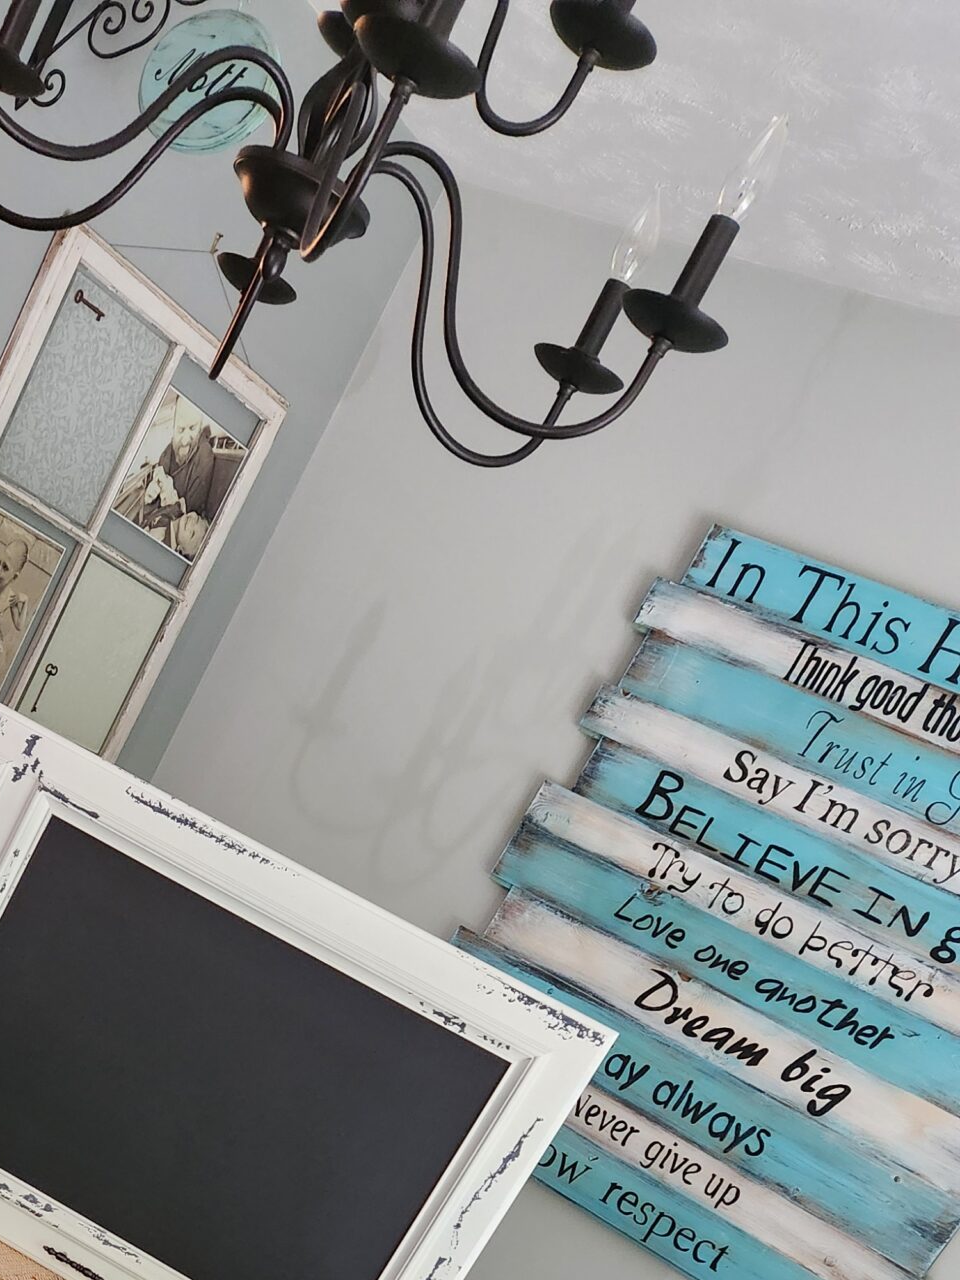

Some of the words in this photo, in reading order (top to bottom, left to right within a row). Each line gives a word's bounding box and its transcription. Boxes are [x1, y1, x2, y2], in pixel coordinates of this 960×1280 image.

[707, 538, 767, 604] In
[789, 564, 912, 655] This
[783, 638, 861, 703] Think
[848, 663, 932, 723] good
[797, 710, 893, 787] Trust
[892, 755, 927, 802] in
[634, 769, 852, 908] BELIEVE
[851, 885, 931, 938] IN
[723, 749, 796, 805] Say
[792, 778, 860, 834] I'm
[863, 818, 960, 885] sorry
[613, 893, 687, 949] Love
[693, 944, 750, 981] one
[754, 978, 896, 1050] another
[647, 841, 702, 893] Try
[708, 877, 745, 916] to
[754, 901, 794, 940] do
[798, 920, 935, 1002] better
[634, 968, 770, 1067] Dream
[780, 1048, 852, 1117] big
[574, 1093, 641, 1148] Never
[640, 1141, 703, 1187] give
[704, 1172, 742, 1210] up
[651, 1079, 772, 1158] always
[598, 1181, 731, 1273] respect
